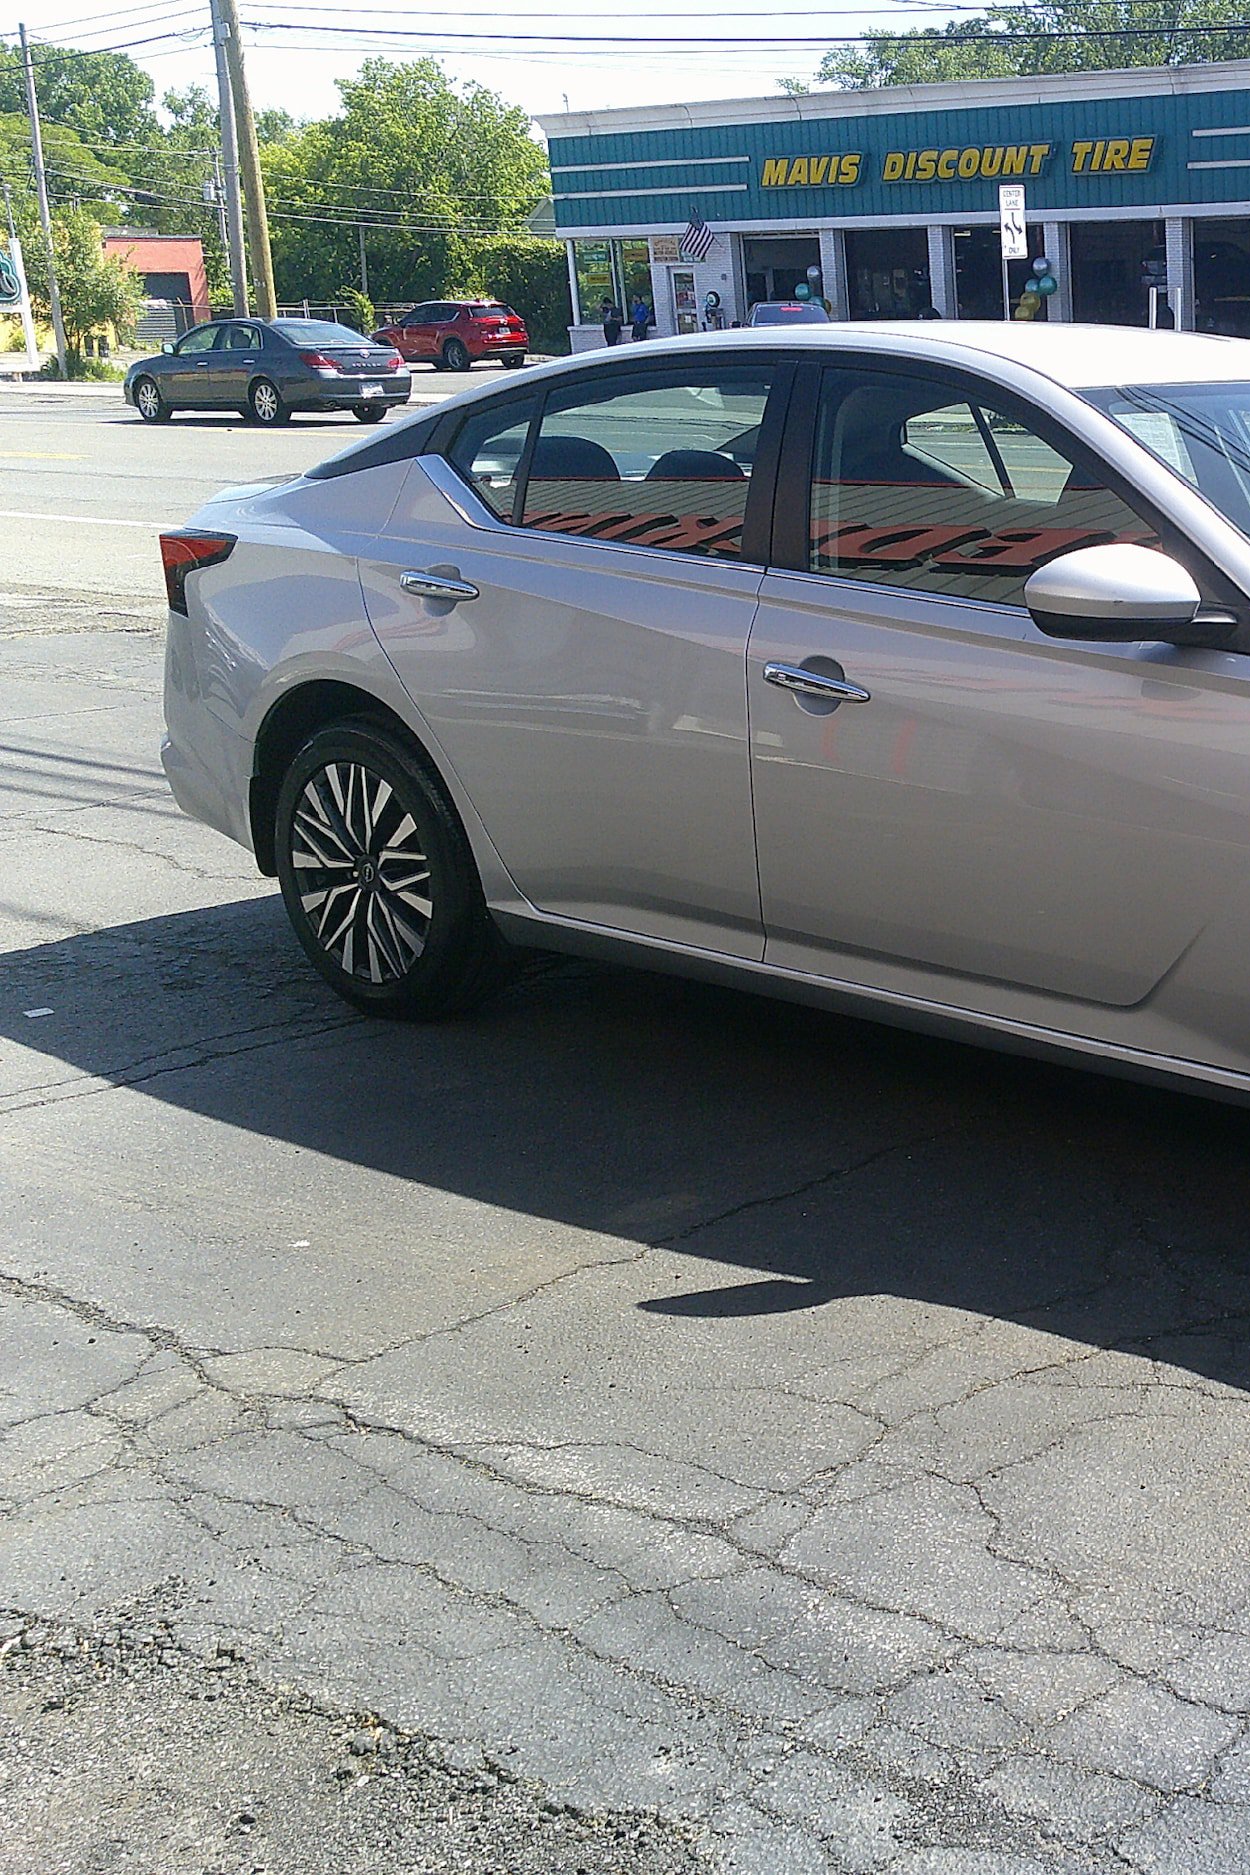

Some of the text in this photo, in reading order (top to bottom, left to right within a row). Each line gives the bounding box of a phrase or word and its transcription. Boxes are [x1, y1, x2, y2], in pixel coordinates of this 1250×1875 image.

[761, 138, 1154, 187] MAVIS DISCOUNT TIRE
